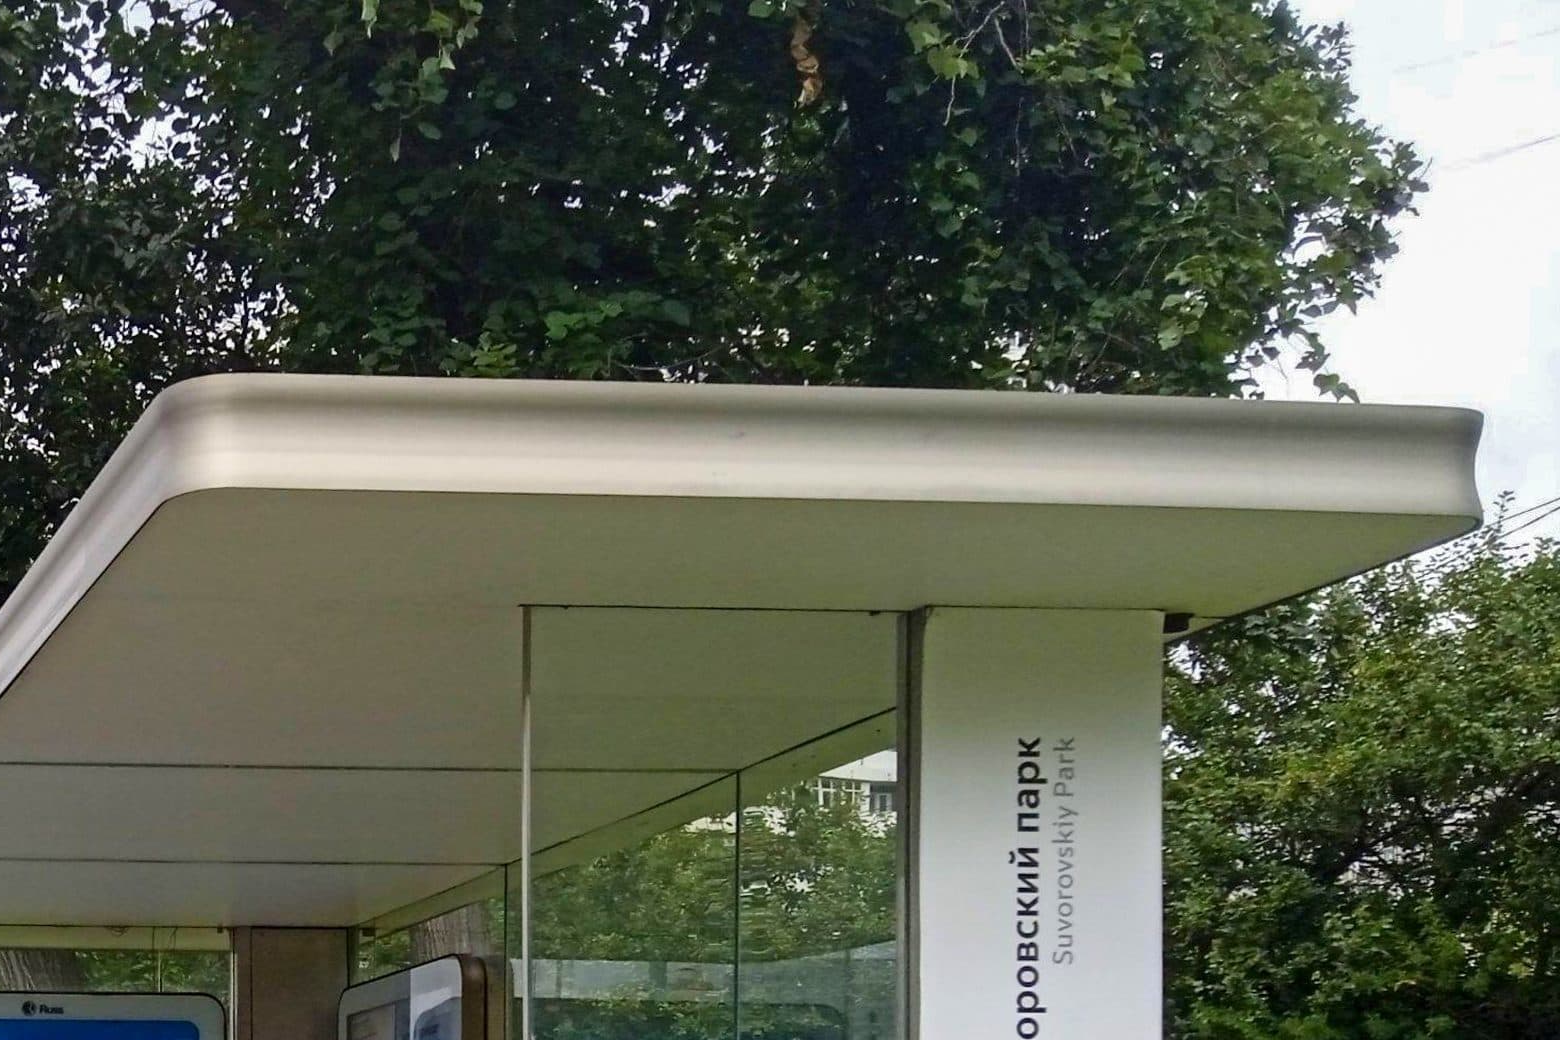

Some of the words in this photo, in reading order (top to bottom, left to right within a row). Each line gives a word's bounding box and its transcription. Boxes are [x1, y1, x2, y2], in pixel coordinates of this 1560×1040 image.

[1017, 737, 1047, 833] парк
[1053, 736, 1077, 797] Park
[1052, 804, 1078, 965] Suvorovskiy
